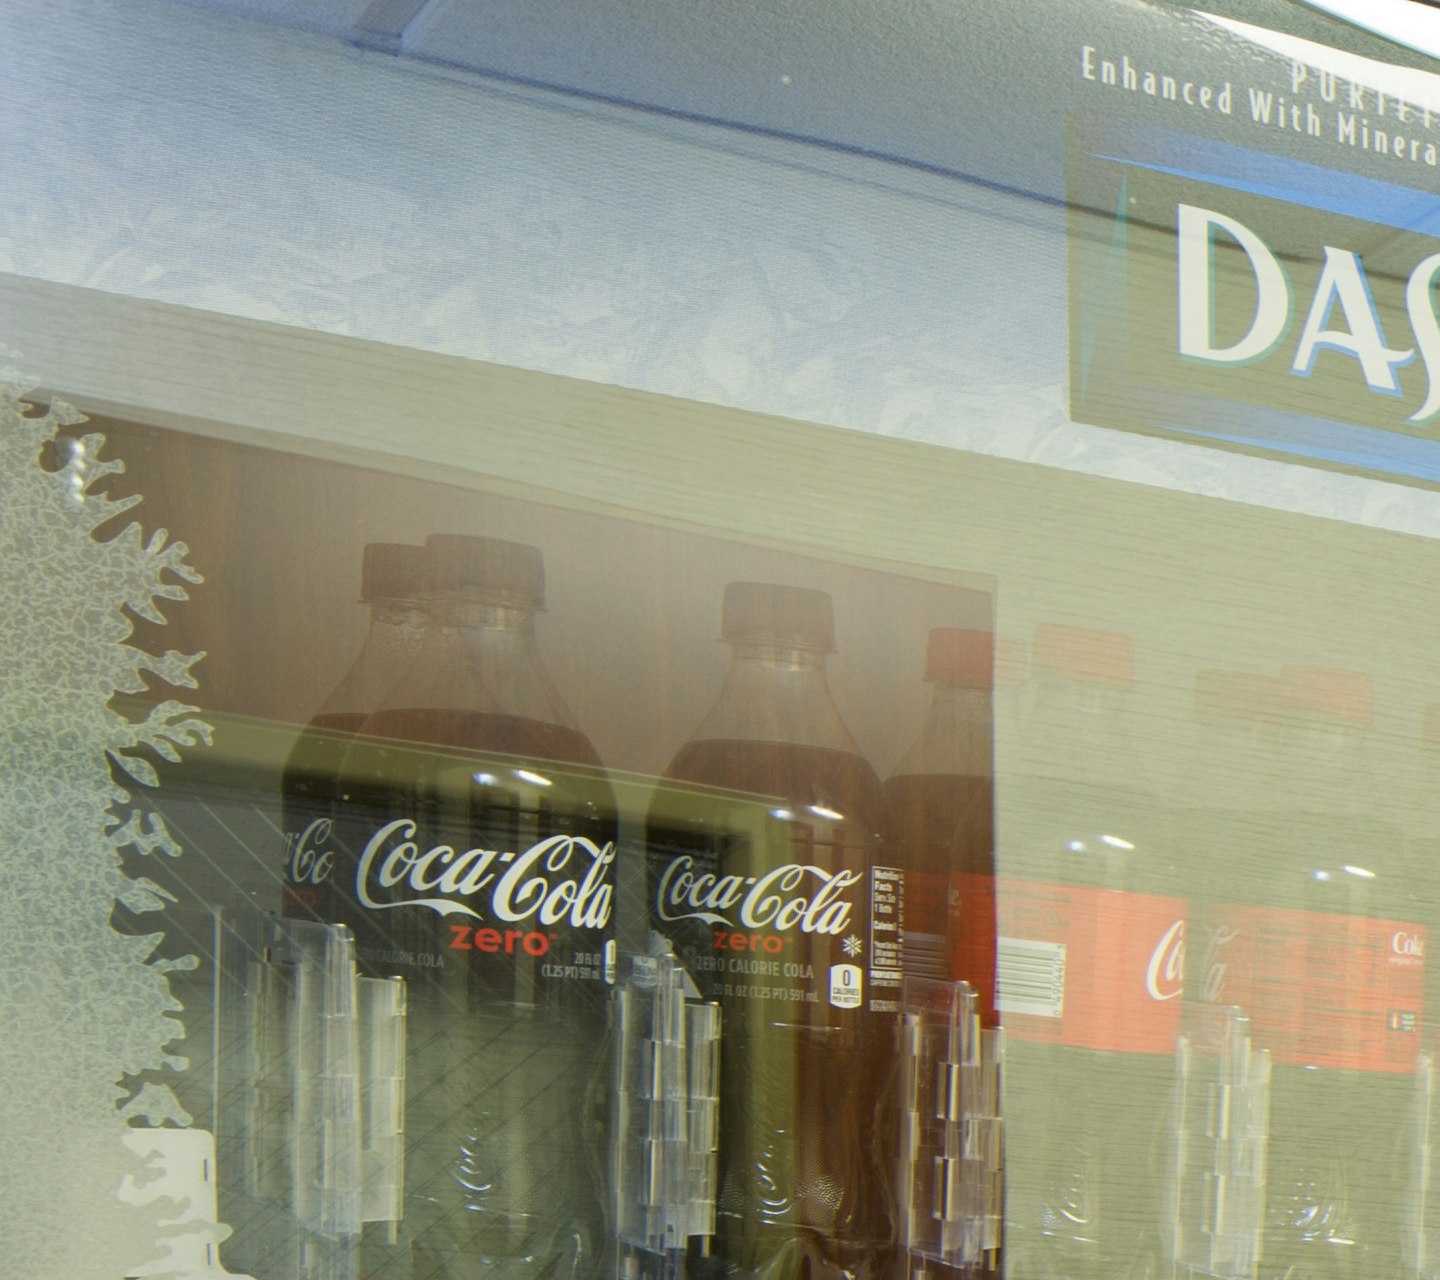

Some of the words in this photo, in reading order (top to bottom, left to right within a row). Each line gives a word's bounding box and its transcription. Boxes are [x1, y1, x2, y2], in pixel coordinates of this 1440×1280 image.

[1082, 46, 1232, 115] Enhanced
[1250, 89, 1321, 137] With
[355, 818, 615, 929] Coca-Cola
[657, 855, 863, 935] Coca-Cola
[450, 925, 550, 956] zero
[714, 931, 783, 954] zero
[697, 956, 725, 972] ZERO
[729, 958, 780, 977] CALORIE
[783, 963, 814, 980] COLA
[842, 969, 851, 986] 0
